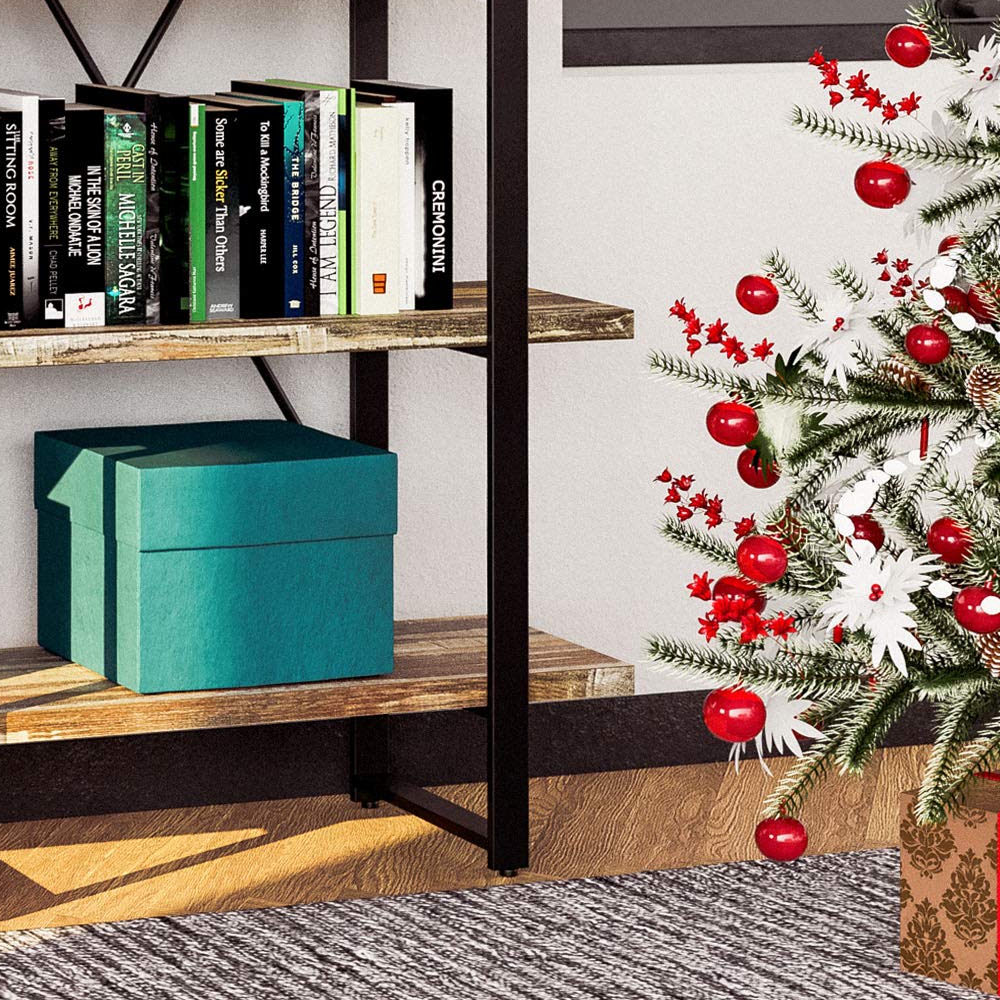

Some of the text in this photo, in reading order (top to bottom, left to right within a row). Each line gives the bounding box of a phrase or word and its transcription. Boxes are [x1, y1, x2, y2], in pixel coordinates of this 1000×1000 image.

[260, 120, 270, 131] To
[260, 133, 270, 148] Kill
[6, 123, 17, 228] SITTING ROOM
[86, 165, 101, 175] IN
[116, 149, 132, 181] PERIL
[132, 144, 145, 183] CAST IN
[49, 146, 58, 240] AWAY FROM EVERYWHERE
[86, 177, 101, 195] THE
[215, 117, 227, 272] Some are Sicker Than Others
[257, 157, 270, 213] Mockingbird
[291, 156, 300, 221] THE BRIDGE
[68, 175, 82, 257] MICHAEL ONDAATJE
[86, 197, 101, 219] SKIN
[86, 220, 101, 234] OF
[320, 185, 337, 247] LEGEND
[432, 180, 446, 273] CREMONINI
[49, 250, 58, 295] CHAD PELLEY
[86, 243, 101, 266] LION
[118, 193, 136, 315] MICHELLE SAGARA
[320, 250, 337, 282] AM
